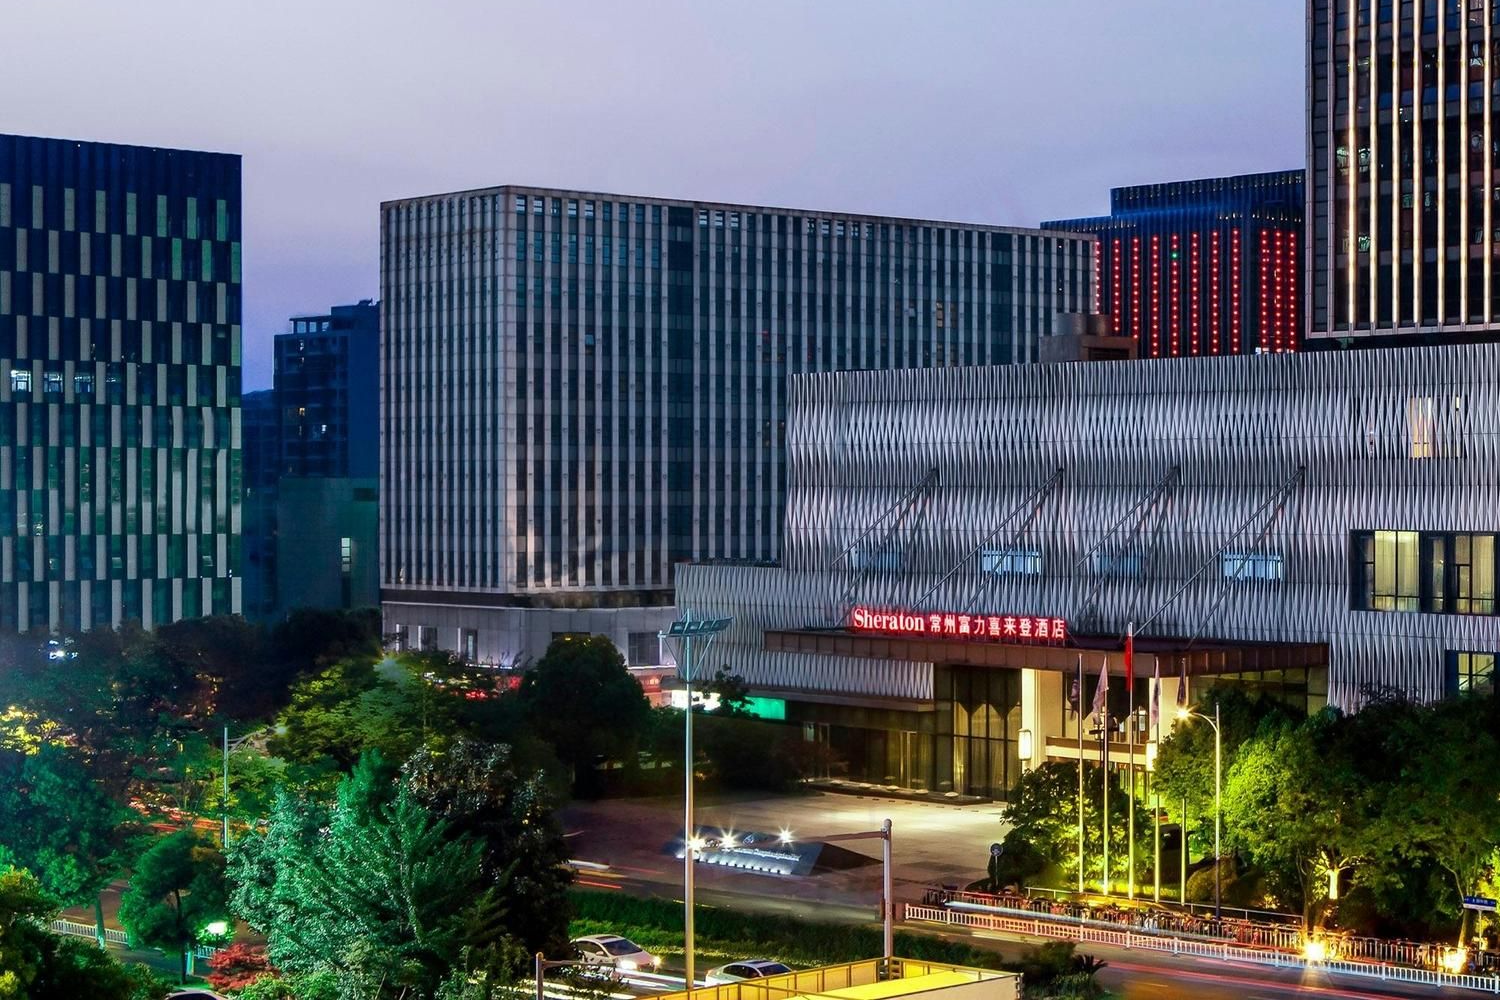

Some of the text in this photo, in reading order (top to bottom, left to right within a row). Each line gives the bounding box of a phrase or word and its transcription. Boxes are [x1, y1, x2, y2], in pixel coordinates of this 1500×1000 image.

[854, 609, 1065, 638] Sheraton 常州富力喜来登酒店
